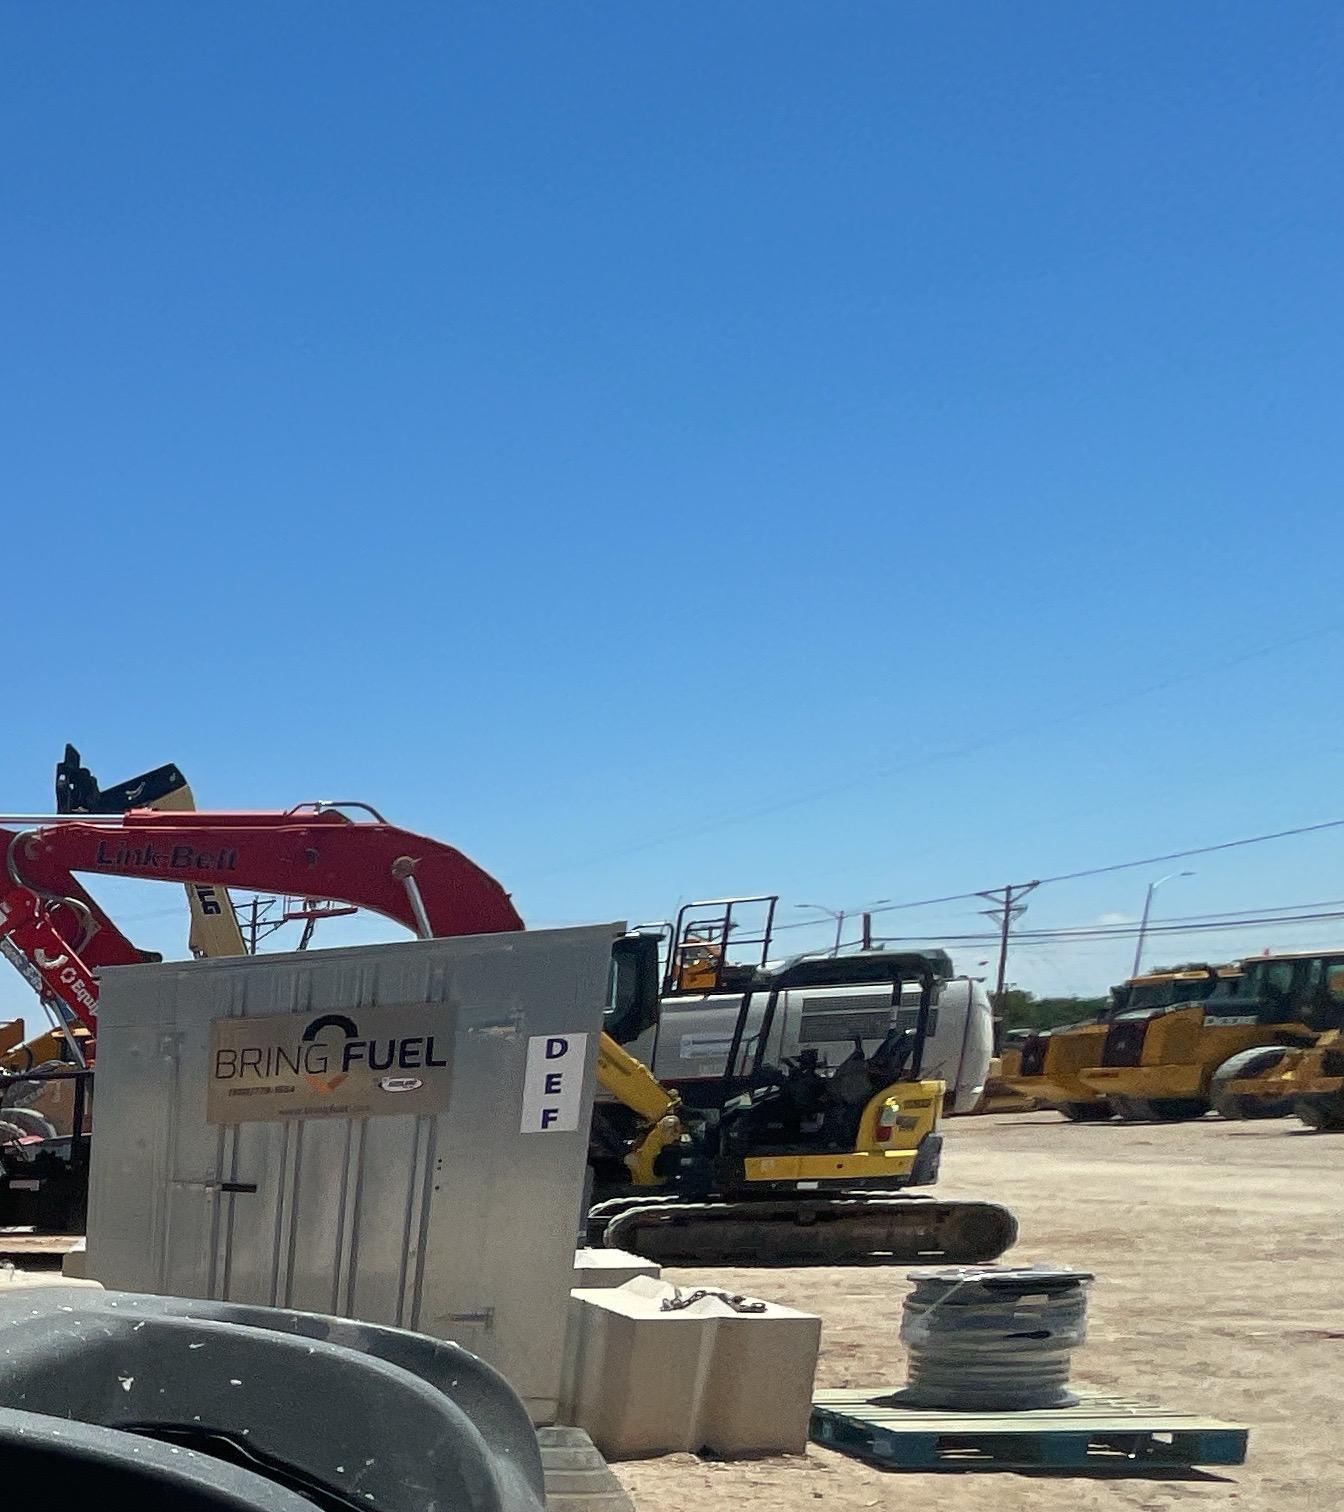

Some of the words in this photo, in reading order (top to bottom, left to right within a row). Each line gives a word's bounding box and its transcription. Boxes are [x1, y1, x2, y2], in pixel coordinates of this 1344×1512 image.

[95, 839, 237, 870] Link-Belt
[214, 1042, 330, 1079] BRING
[341, 1035, 448, 1073] FUEL
[541, 1038, 569, 1129] DEF
